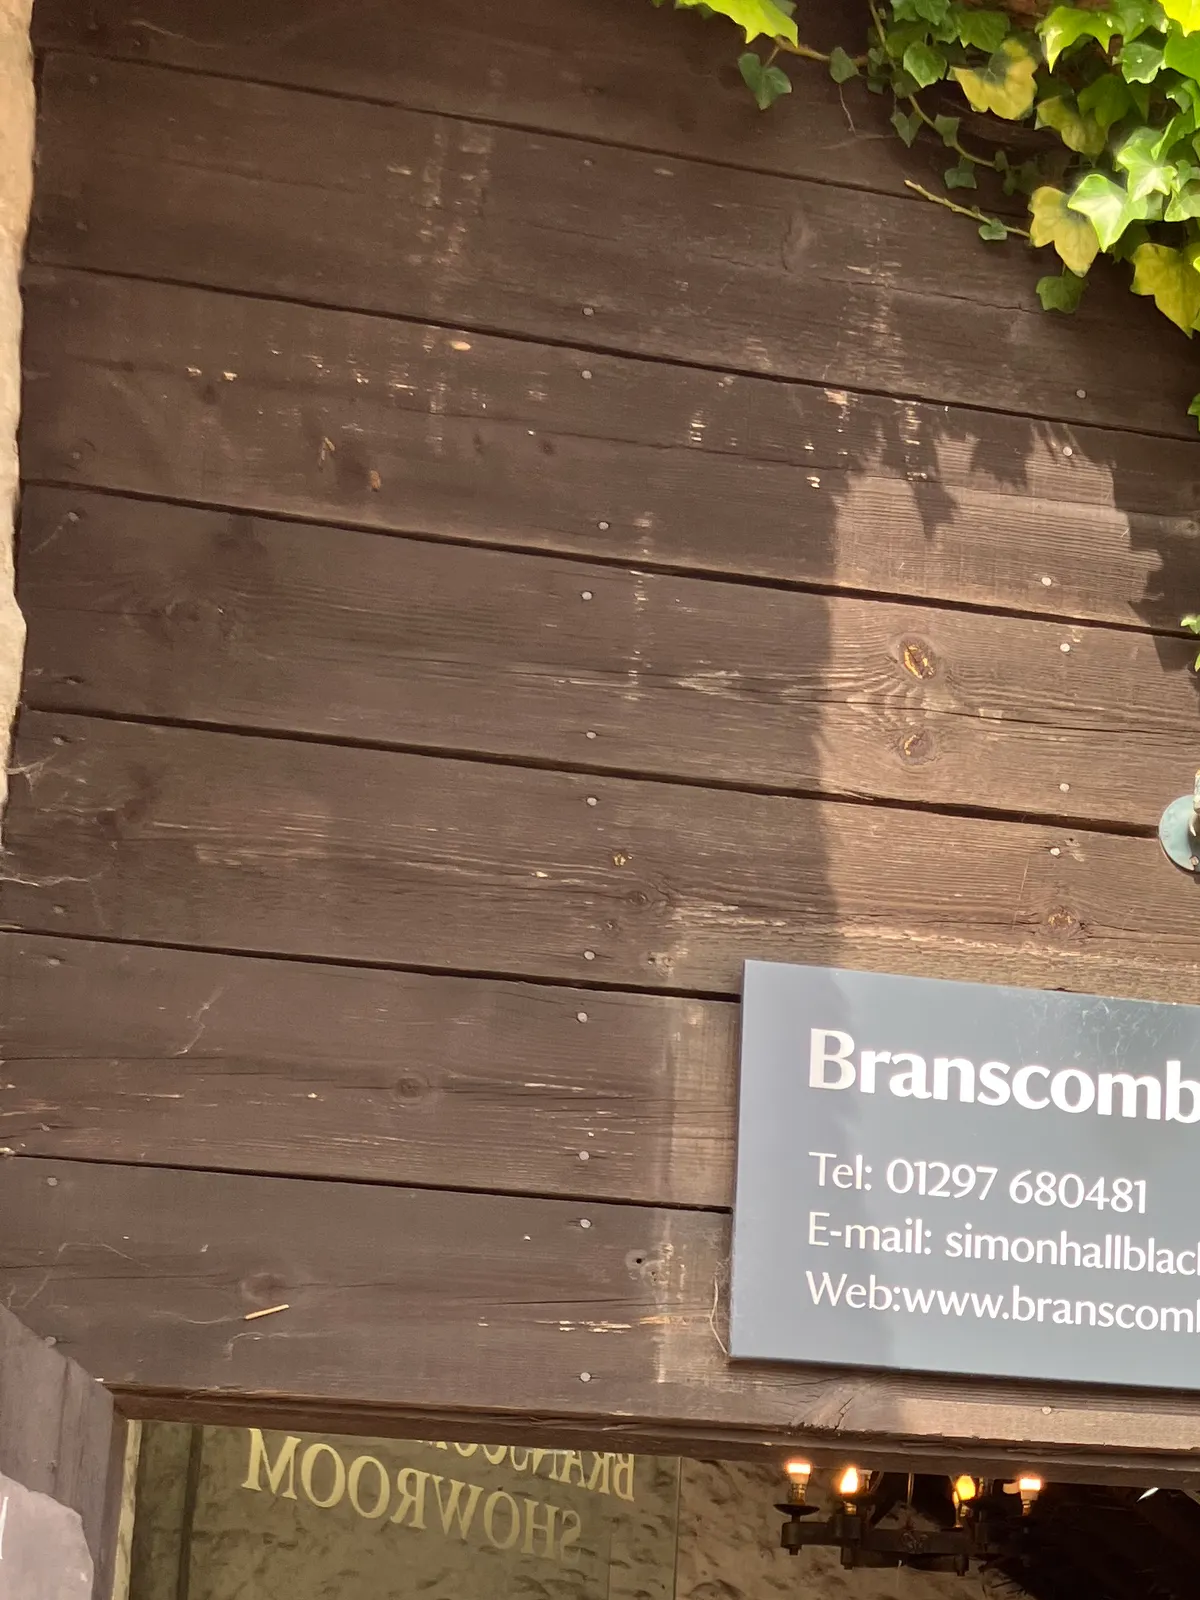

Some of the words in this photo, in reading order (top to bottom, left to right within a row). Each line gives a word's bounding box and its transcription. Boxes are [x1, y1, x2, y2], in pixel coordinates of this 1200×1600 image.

[808, 1151, 873, 1191] Tel:
[886, 1158, 999, 1201] 01297
[1009, 1170, 1147, 1214] 680481
[808, 1212, 932, 1255] E-mail:
